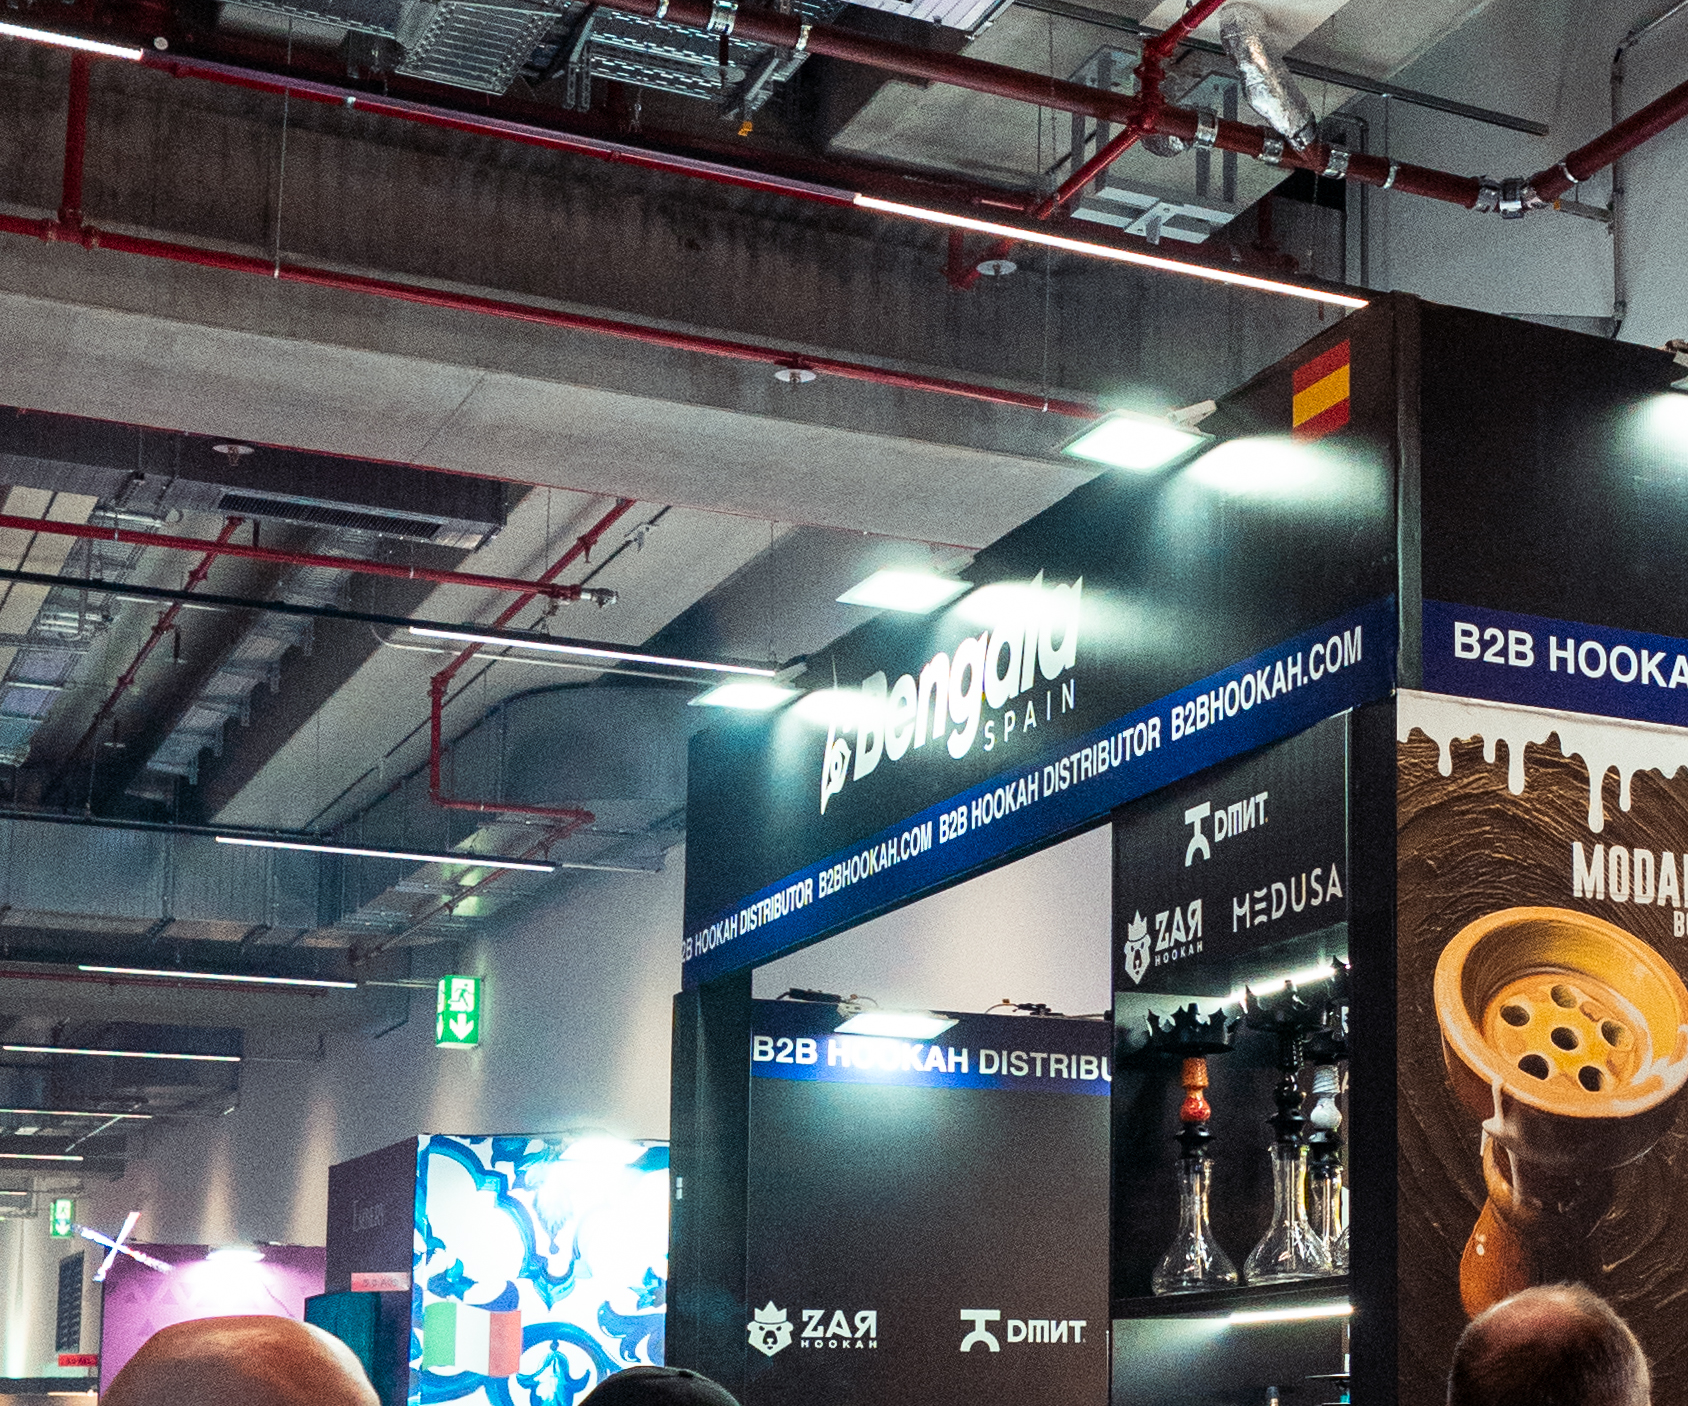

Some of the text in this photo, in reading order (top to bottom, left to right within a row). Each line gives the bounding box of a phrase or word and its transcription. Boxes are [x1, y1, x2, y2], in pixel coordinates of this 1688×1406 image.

[1454, 622, 1535, 667] B2B
[853, 568, 1083, 781] Bengala
[983, 679, 1075, 751] SPAIN
[695, 913, 738, 957] HOOKAH
[740, 877, 813, 936] DISTRIBUTOR
[818, 820, 933, 899] B2BHOOKAH.COM
[939, 810, 968, 845] B2B
[971, 771, 1039, 830] HOOKAH
[1043, 717, 1160, 795] DISTRIBUTOR
[1171, 625, 1363, 742] B2BHOOKAH.COM
[1232, 862, 1343, 932] MEDUSA
[1154, 941, 1203, 967] HOOKAH
[752, 1036, 818, 1064] B2B
[800, 1340, 877, 1349] HOOKAH
